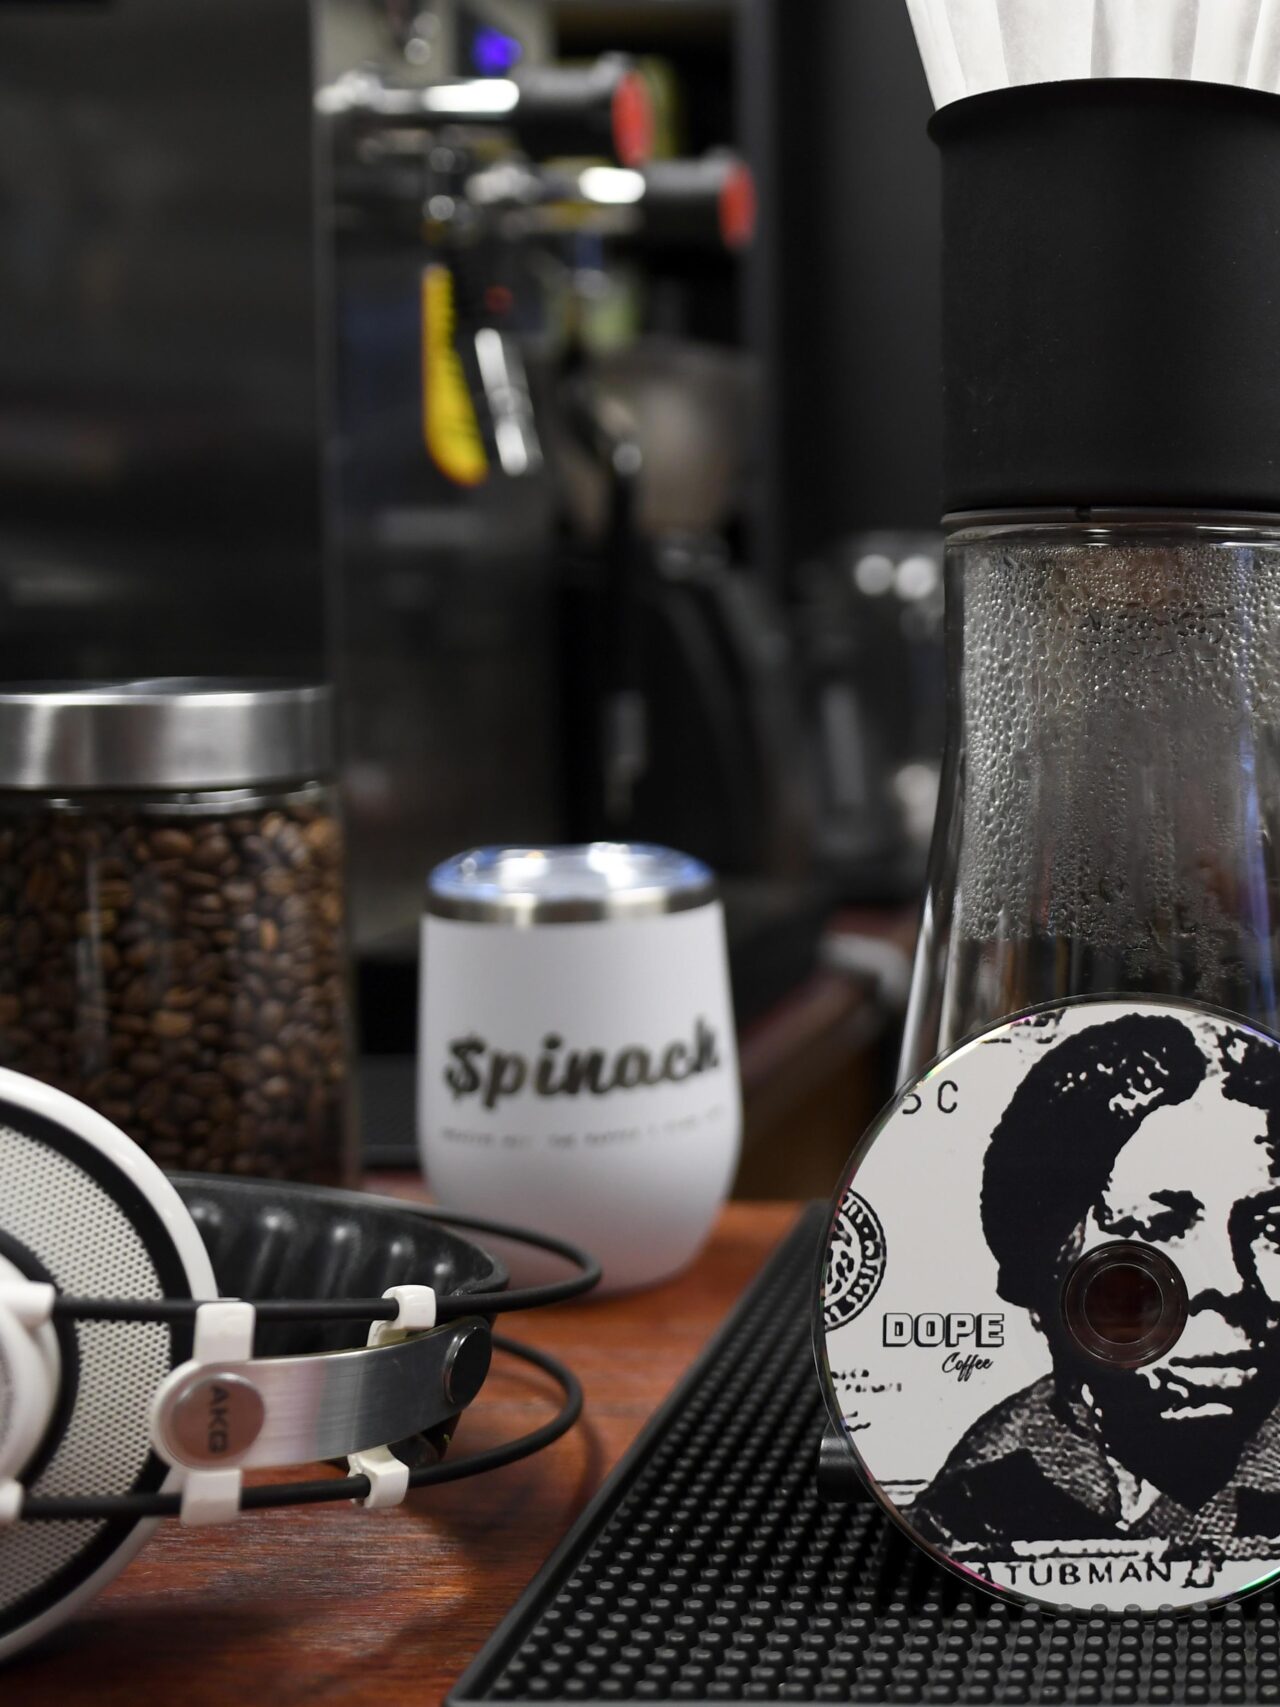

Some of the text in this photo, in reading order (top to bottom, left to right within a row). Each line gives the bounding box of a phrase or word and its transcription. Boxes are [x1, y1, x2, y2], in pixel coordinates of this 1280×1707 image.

[937, 1080, 959, 1115] C
[882, 1312, 1005, 1348] DOPE
[941, 1351, 995, 1381] Coffee
[206, 1385, 230, 1454] AKG
[1005, 1560, 1173, 1586] TUBMAN
